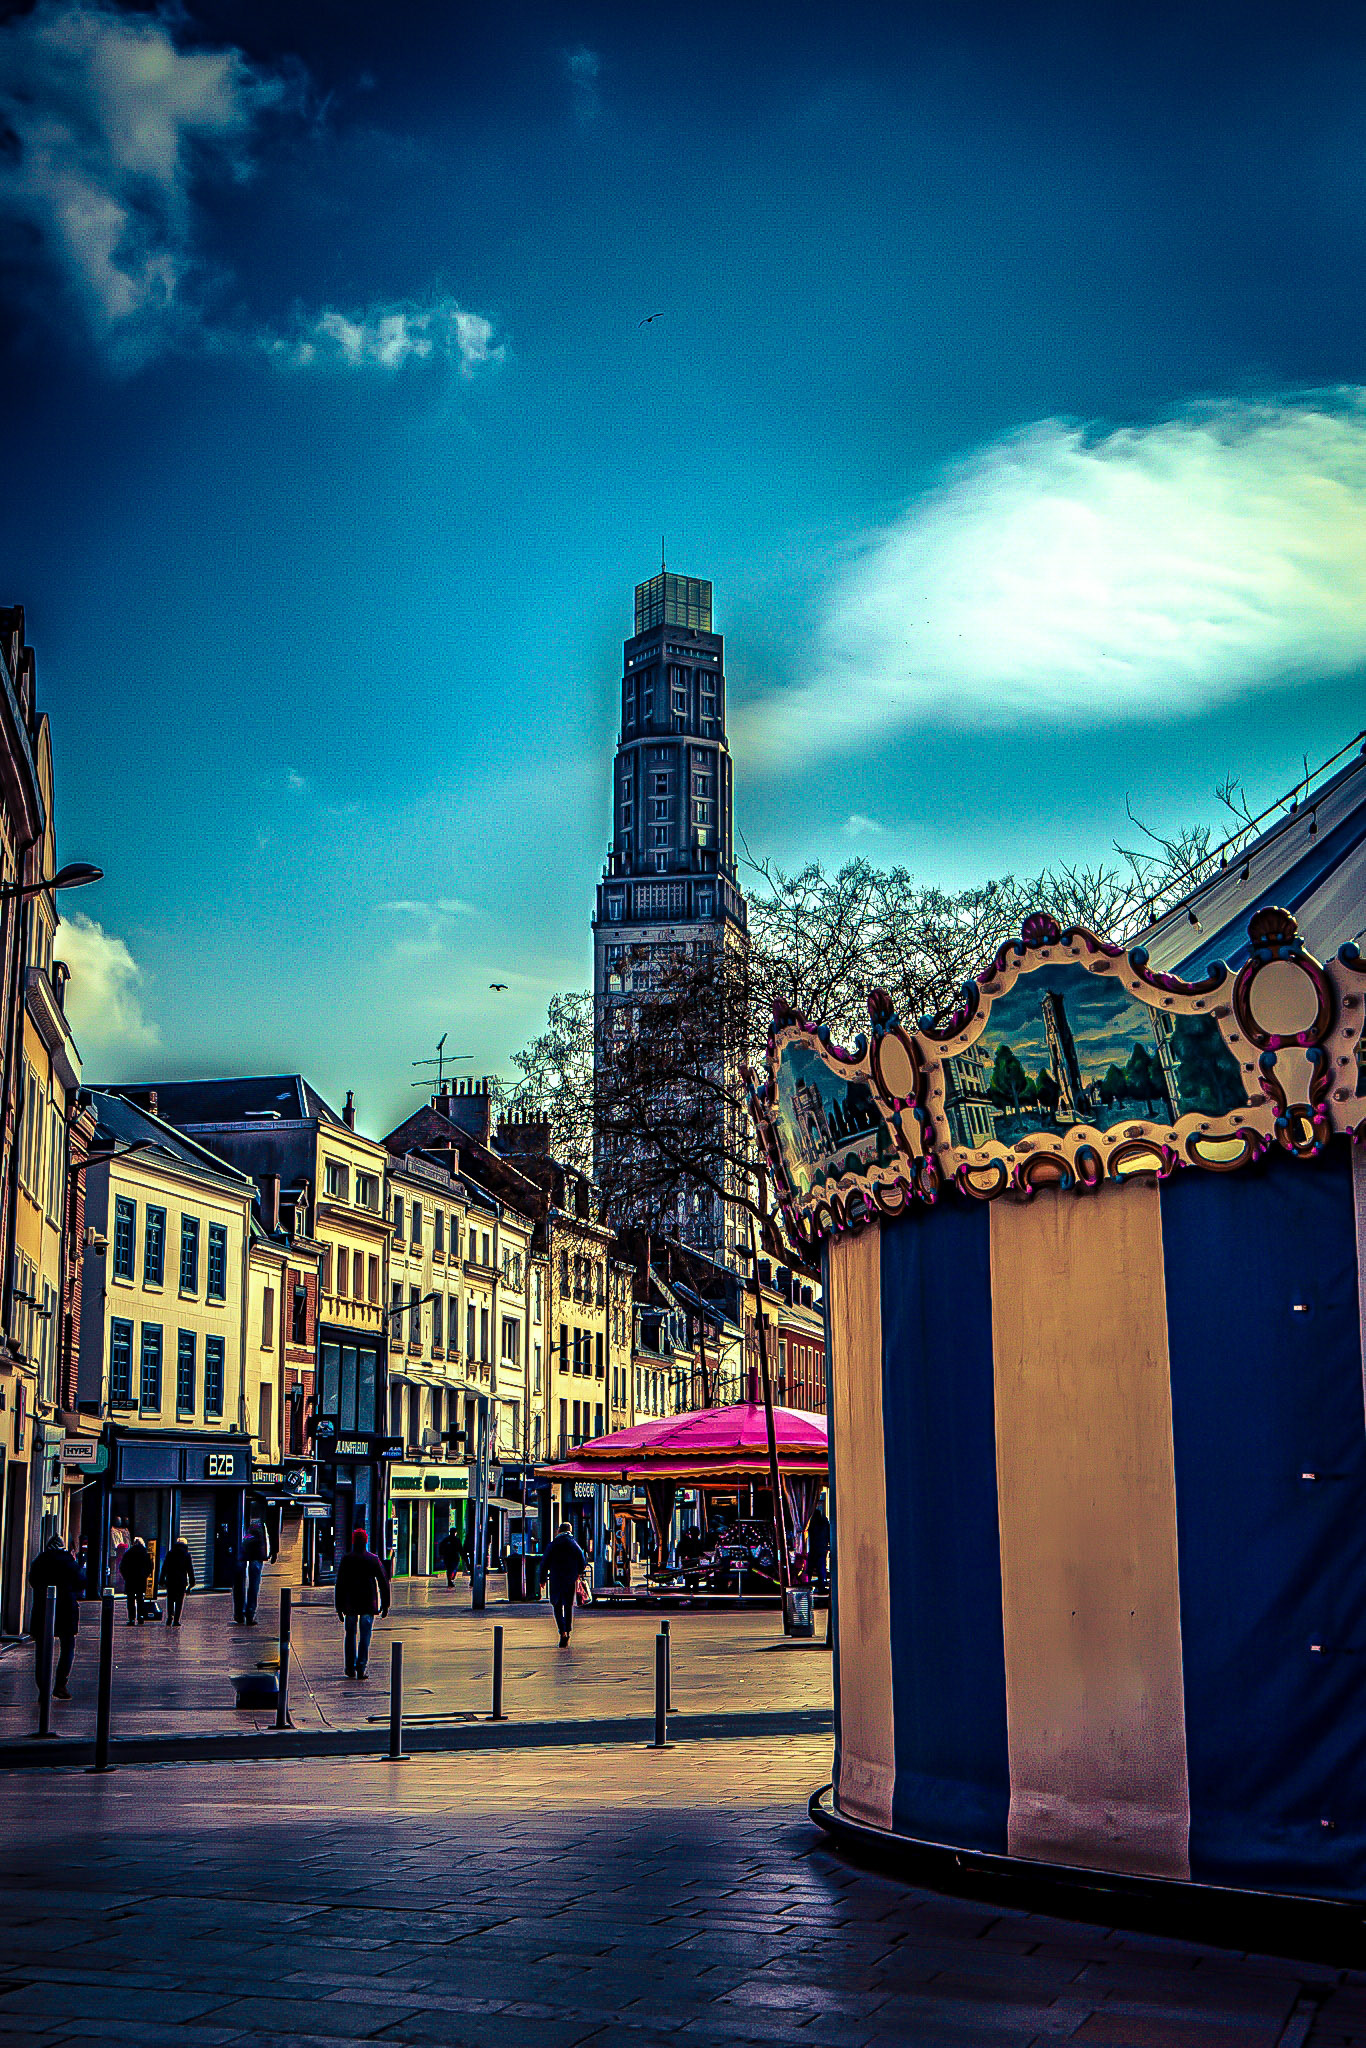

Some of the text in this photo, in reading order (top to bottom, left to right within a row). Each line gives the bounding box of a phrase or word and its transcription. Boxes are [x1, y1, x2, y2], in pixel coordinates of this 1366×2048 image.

[111, 1400, 135, 1409] BZB
[66, 1447, 92, 1455] HYPE
[209, 1454, 234, 1476] BZB
